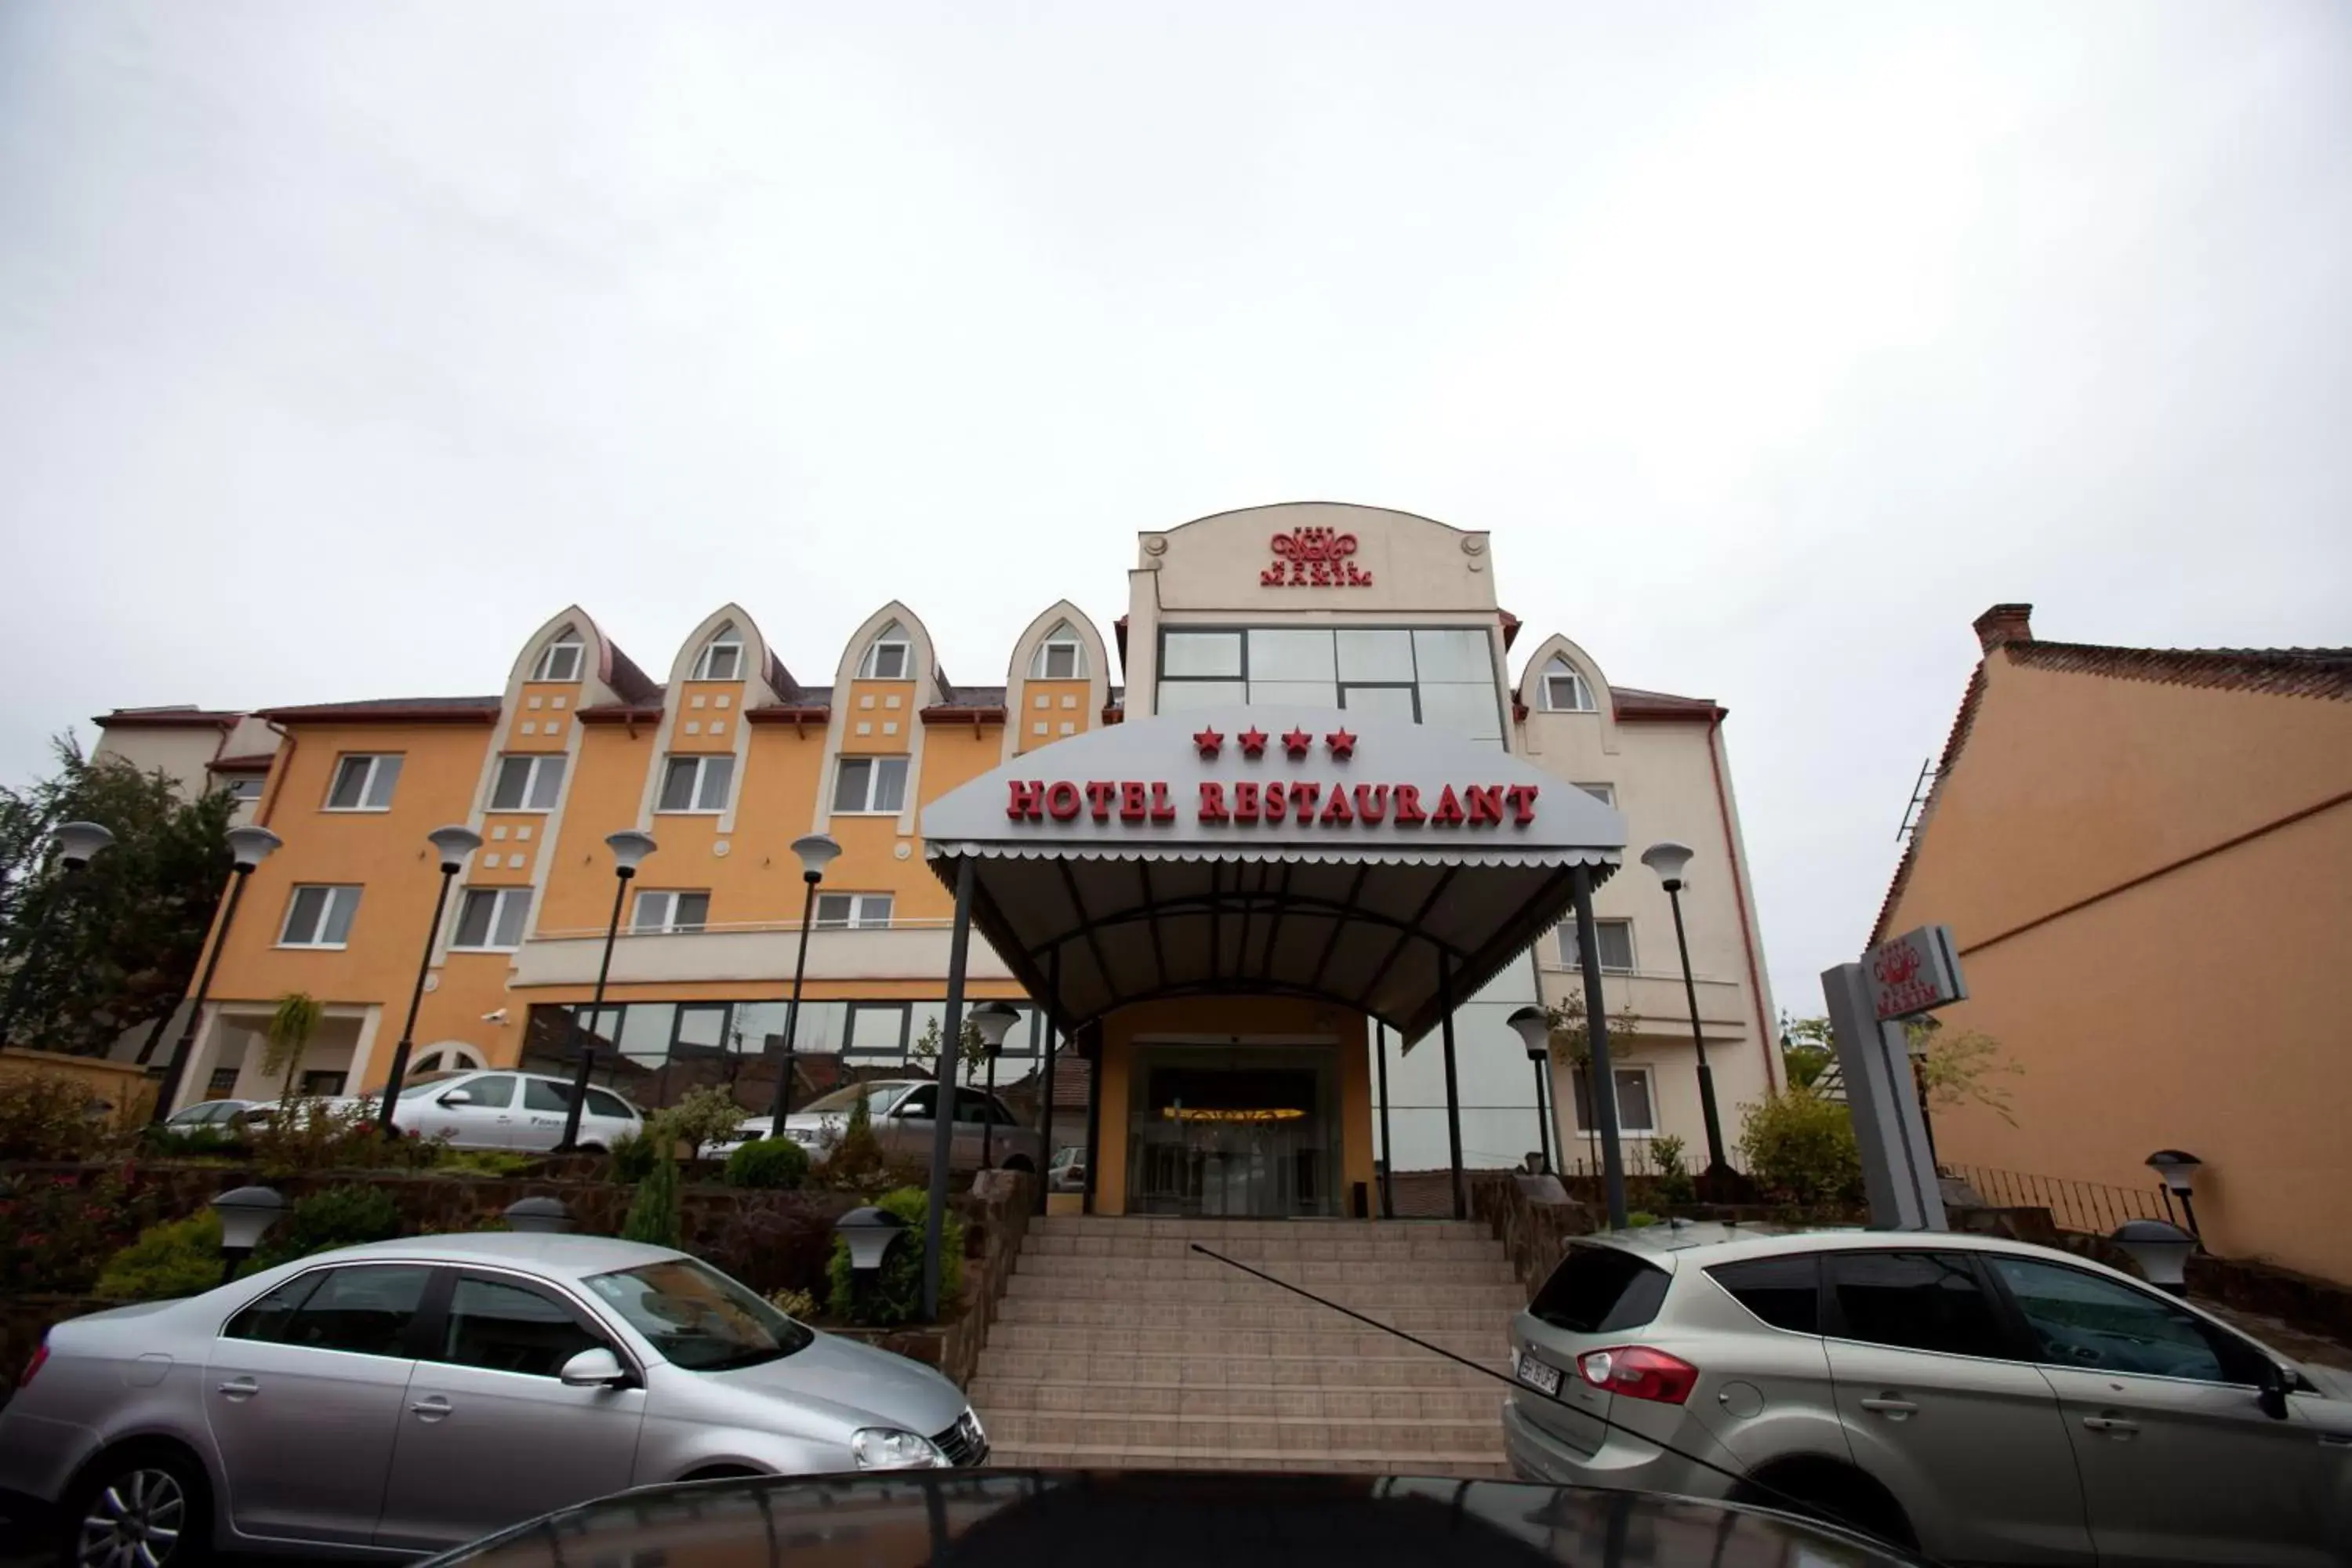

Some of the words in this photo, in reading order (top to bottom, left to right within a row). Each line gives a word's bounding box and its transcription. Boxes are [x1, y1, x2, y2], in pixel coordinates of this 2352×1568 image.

[1007, 781, 1176, 821] HOTEL
[1198, 782, 1538, 826] RESTAURANT
[1878, 985, 1937, 1018] MAXIM
